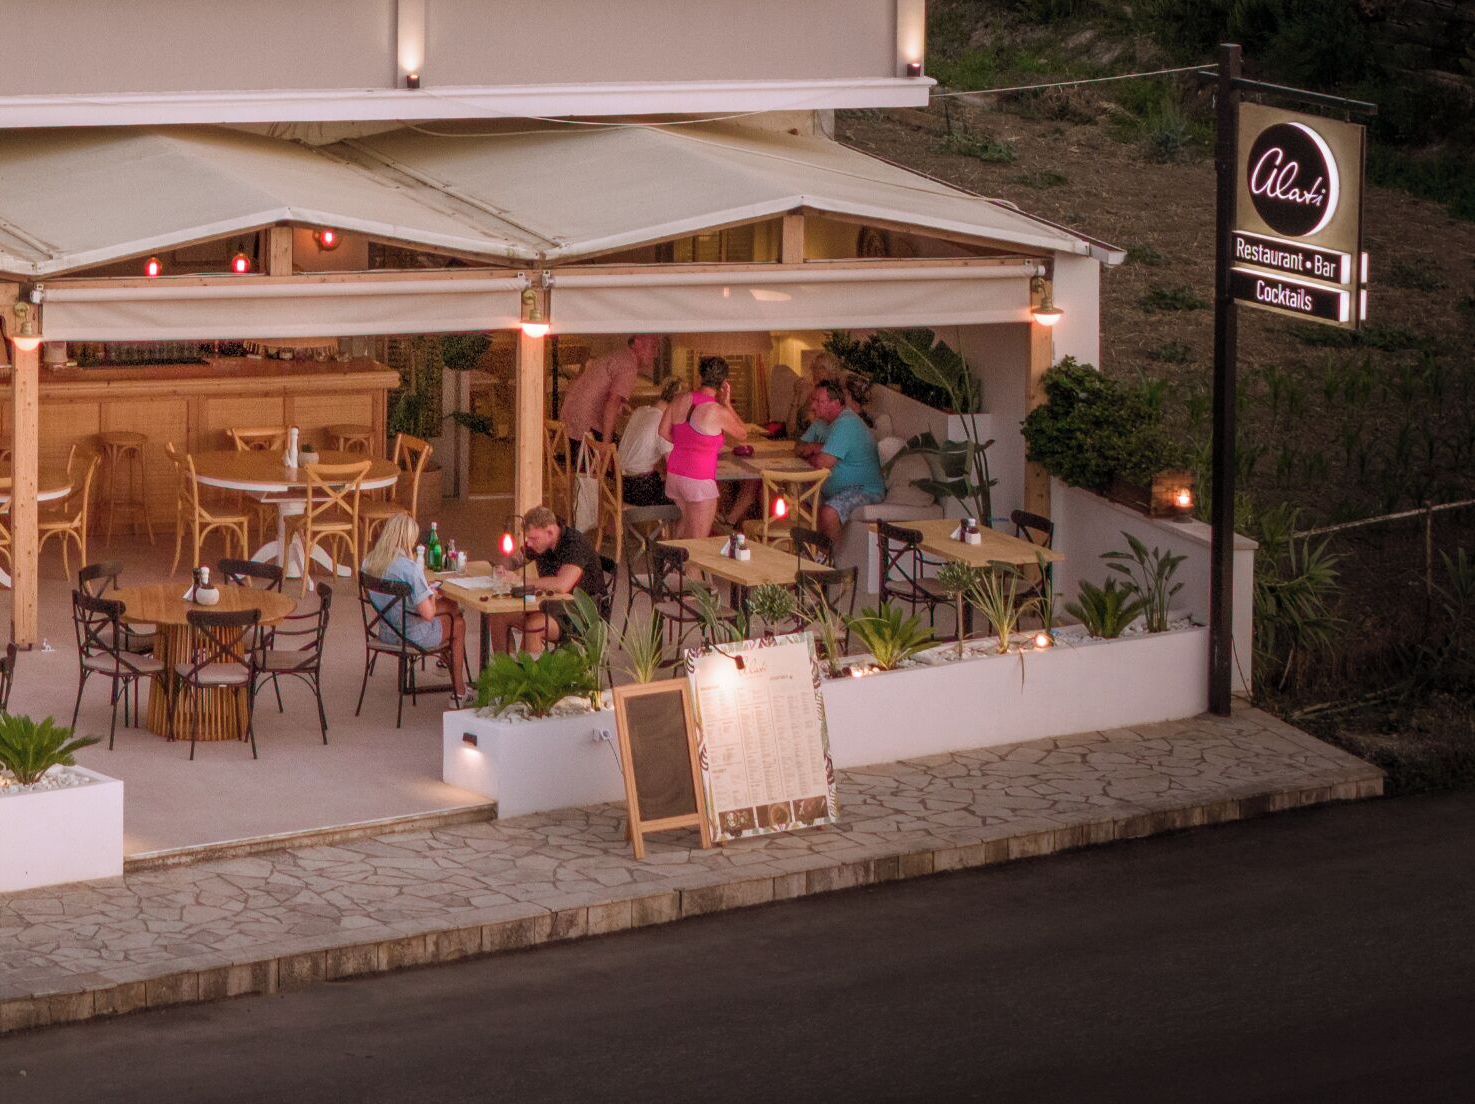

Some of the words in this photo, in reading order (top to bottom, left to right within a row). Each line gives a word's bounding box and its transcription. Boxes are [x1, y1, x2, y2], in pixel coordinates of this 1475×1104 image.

[1236, 237, 1304, 272] Restaurant
[1314, 254, 1337, 278] Bar
[1256, 280, 1312, 311] Cocktails
